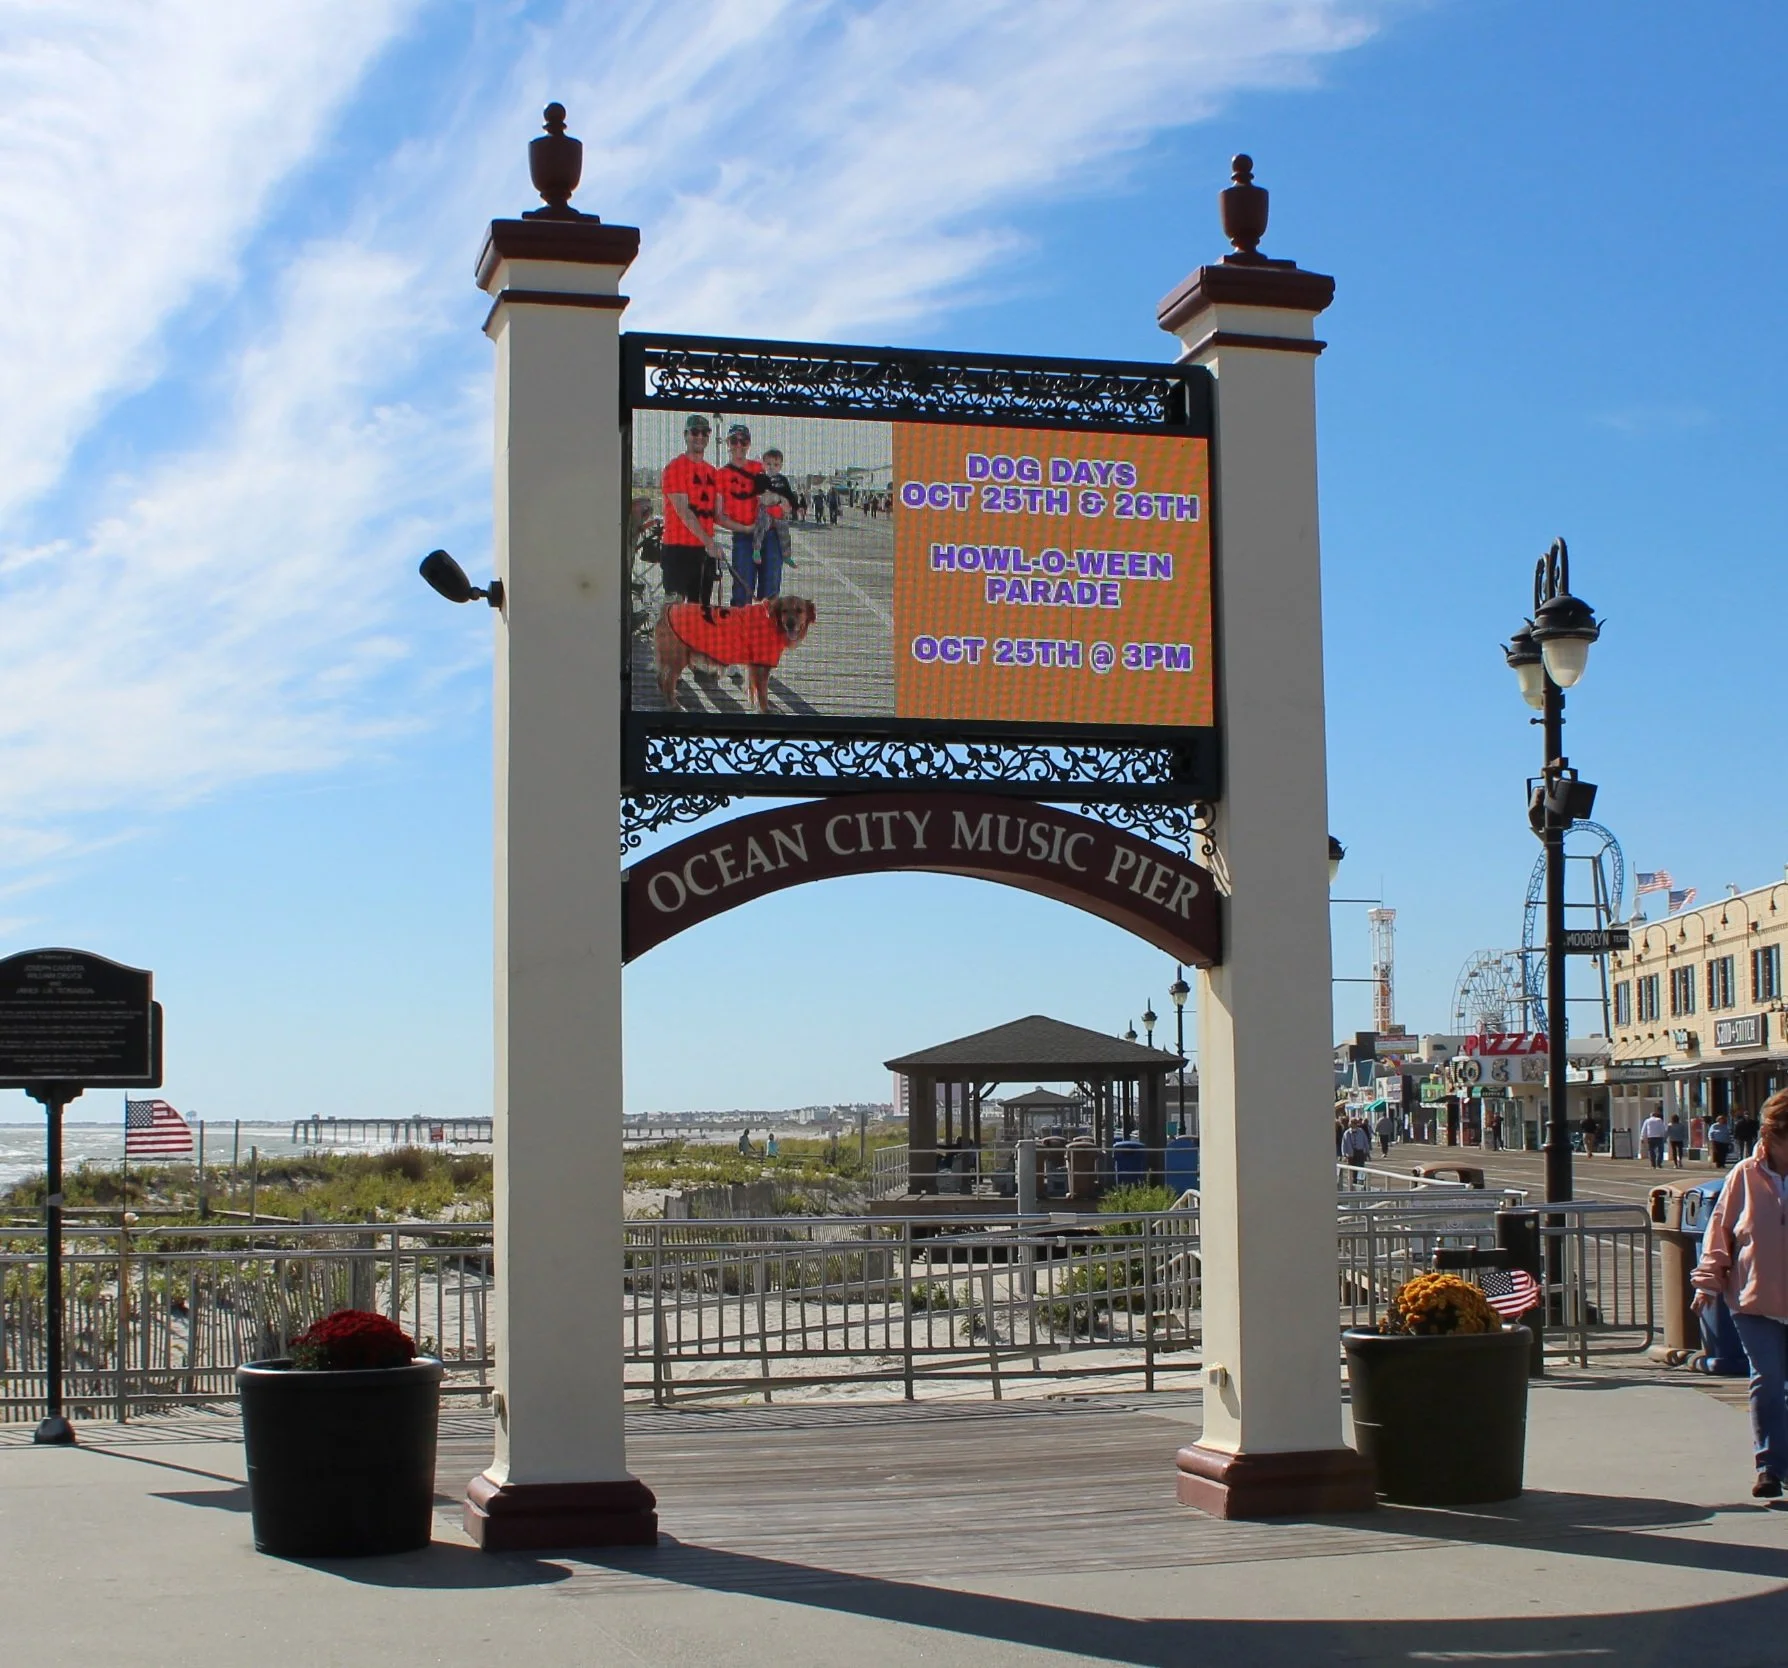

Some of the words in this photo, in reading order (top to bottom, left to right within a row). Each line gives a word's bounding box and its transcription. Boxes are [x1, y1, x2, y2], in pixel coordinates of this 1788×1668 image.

[966, 453, 1041, 484] DOG
[1049, 457, 1137, 488] DAYS
[901, 481, 974, 511] OCT
[981, 484, 1070, 515] 25TH
[1079, 491, 1107, 517] &
[1113, 492, 1199, 522] 26TH
[930, 543, 1173, 580] HOWL-O-WEEN
[985, 576, 1122, 608] PARADE
[912, 635, 987, 665] OCT
[993, 638, 1082, 669] 25TH
[1089, 641, 1116, 674] @
[1122, 643, 1194, 672] 3PM
[647, 823, 809, 913] OCEAN
[825, 809, 932, 856] CITY
[951, 810, 1095, 872] MUSIC
[1104, 844, 1201, 920] PIER
[1566, 932, 1609, 947] MOORLYN
[1464, 1032, 1548, 1056] PIZZA
